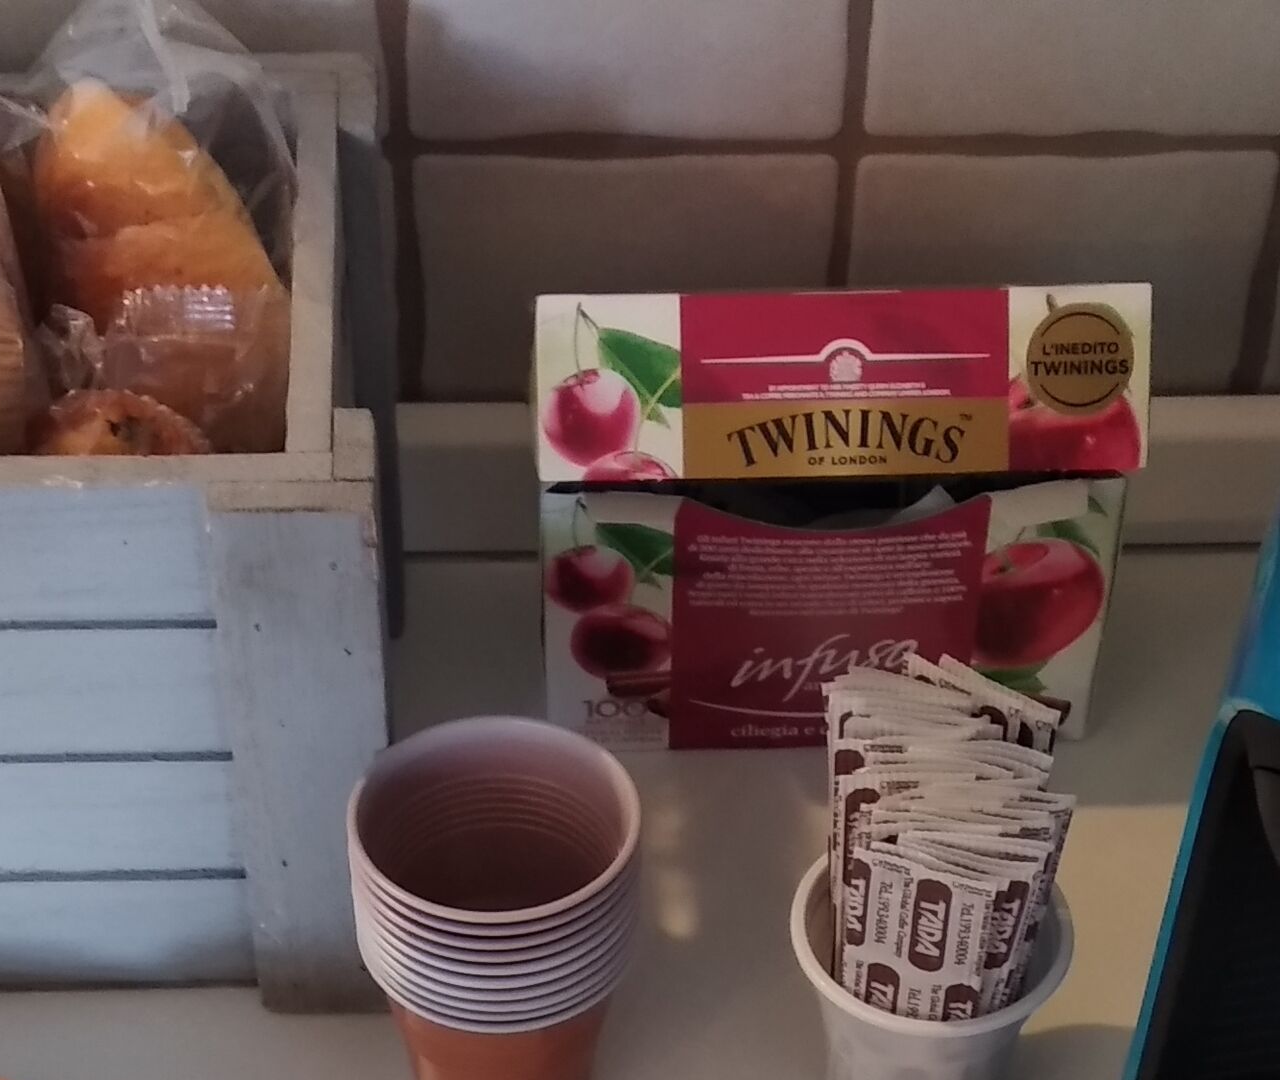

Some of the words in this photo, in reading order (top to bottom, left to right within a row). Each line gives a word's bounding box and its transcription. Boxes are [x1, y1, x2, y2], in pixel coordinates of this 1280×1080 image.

[1042, 342, 1120, 356] L'INEDITO
[1030, 359, 1129, 376] TWININGS
[727, 408, 966, 467] TWININGS
[808, 456, 824, 466] OF
[831, 455, 888, 466] LONDON
[729, 724, 799, 738] ciliegia
[915, 898, 944, 958] TADA
